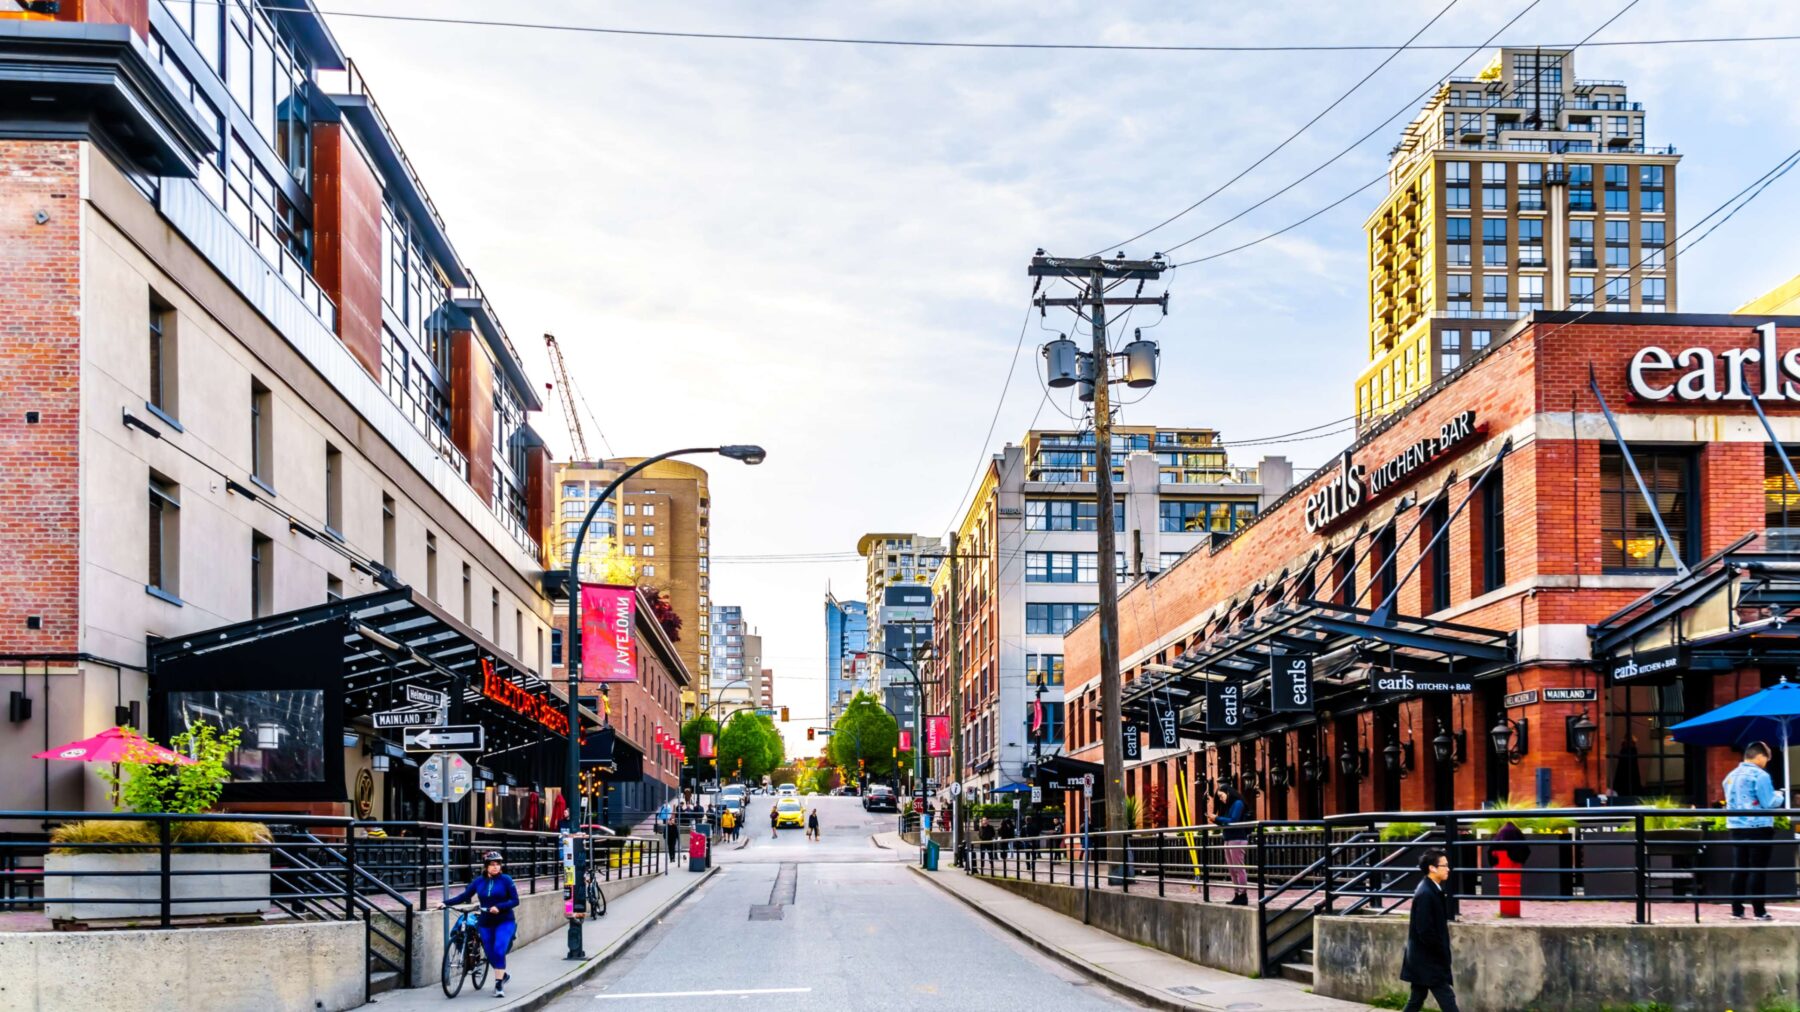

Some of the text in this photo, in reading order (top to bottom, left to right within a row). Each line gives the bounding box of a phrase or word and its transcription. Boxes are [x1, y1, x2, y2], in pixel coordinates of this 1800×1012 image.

[1305, 411, 1470, 533] earls KITCHEN + BAR
[1614, 659, 1638, 679] earls
[1639, 662, 1661, 674] KITCHEN
[1665, 658, 1677, 668] BAR
[1287, 659, 1307, 705] earls
[1378, 674, 1414, 690] earls
[1416, 683, 1449, 691] KITCHEN
[1456, 683, 1471, 691] BAR
[1546, 690, 1585, 699] MAINLAND
[1220, 686, 1237, 726] earls
[379, 713, 420, 726] MAINLAND
[1160, 710, 1175, 745] earls
[1124, 725, 1137, 757] earls
[913, 801, 923, 809] STO
[1033, 790, 1040, 799] 30
